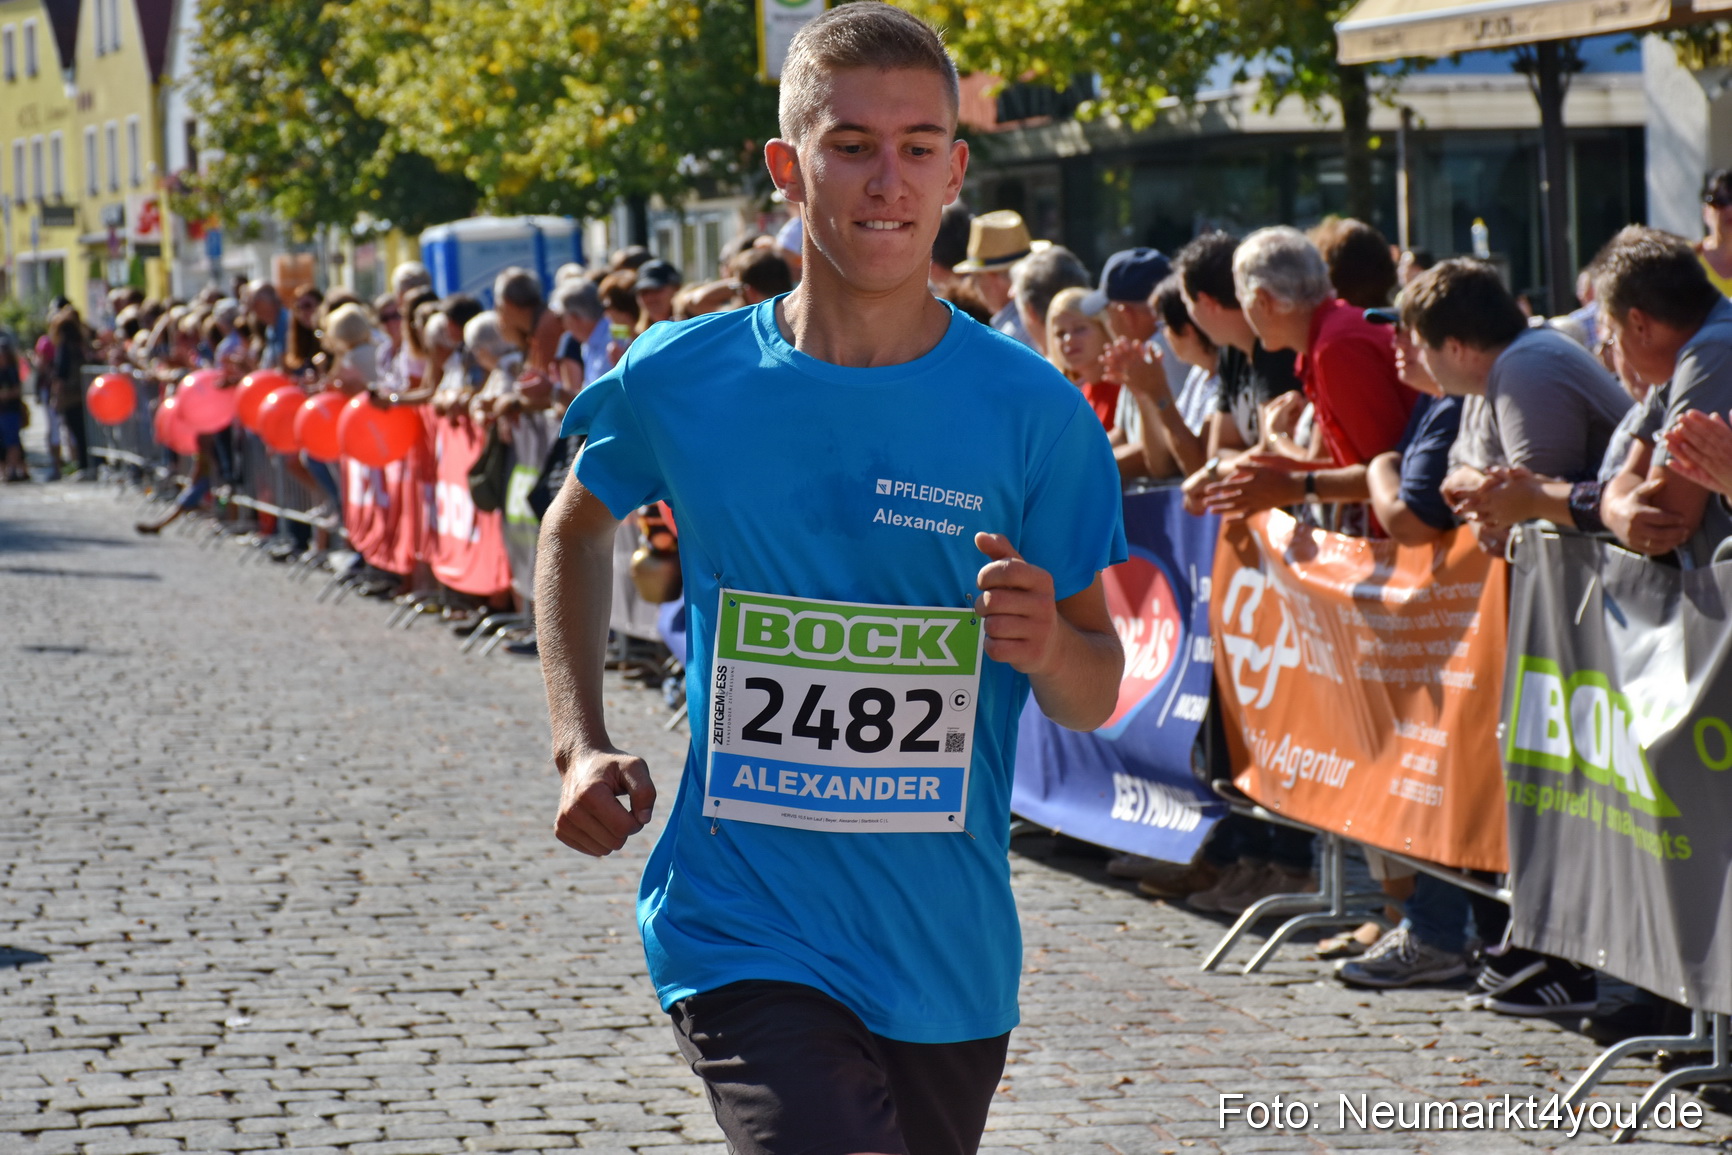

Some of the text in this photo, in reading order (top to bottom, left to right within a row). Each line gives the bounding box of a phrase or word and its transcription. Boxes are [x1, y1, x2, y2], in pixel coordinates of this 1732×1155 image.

[893, 481, 983, 511] PFLEIDERER
[873, 508, 964, 536] Alexander
[737, 603, 960, 666] BOCK
[741, 677, 944, 753] 2482
[954, 694, 965, 706] C
[732, 764, 941, 801] ALEXANDER
